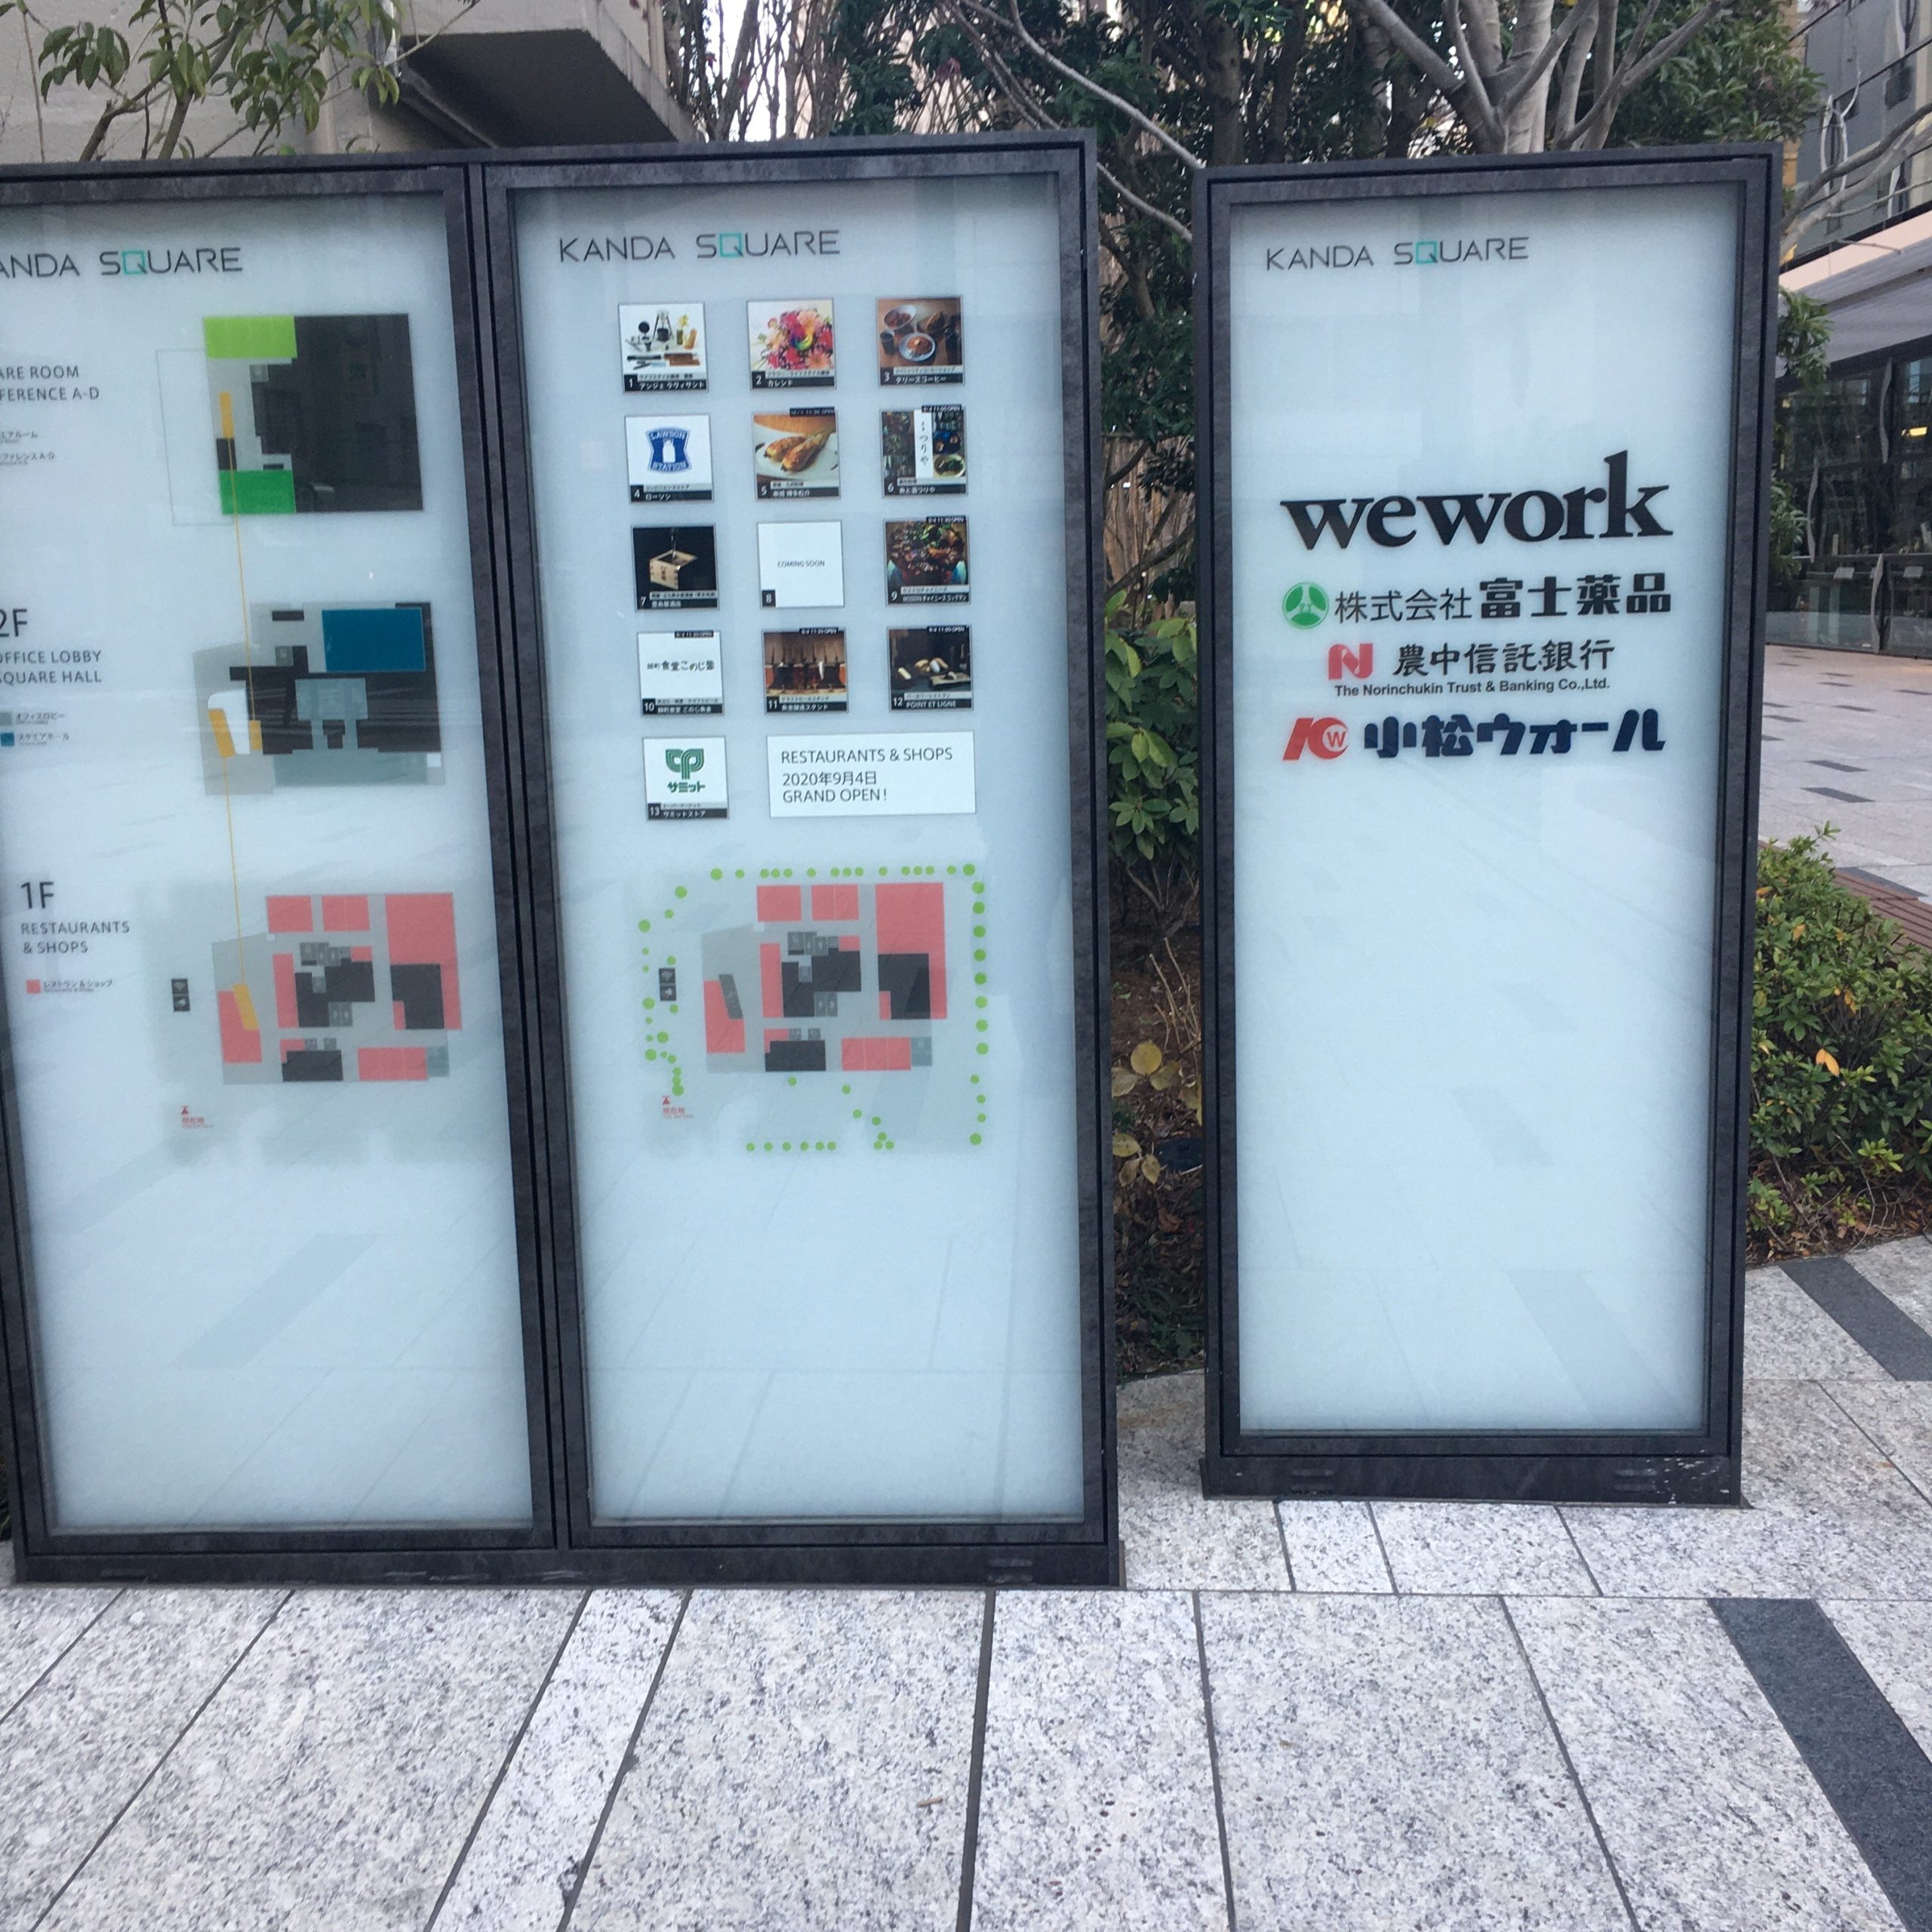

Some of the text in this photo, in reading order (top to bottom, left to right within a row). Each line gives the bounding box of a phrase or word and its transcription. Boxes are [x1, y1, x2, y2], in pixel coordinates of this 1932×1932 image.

[559, 229, 841, 263] KANDA SQUARE
[1266, 236, 1530, 272] KANDA SQUARE
[0, 247, 242, 278] NDA SQUARE
[30, 365, 79, 380] ROOM
[755, 374, 762, 386] 2
[72, 386, 100, 400] A-D
[634, 488, 641, 499] 4
[888, 482, 895, 493] 6
[1280, 450, 1673, 550] wework
[777, 560, 804, 568] COMING
[641, 596, 647, 606] 7
[765, 593, 772, 604] 8
[891, 590, 898, 601] 9
[1334, 572, 1672, 625] 株式会社富士薬品
[0, 608, 28, 638] 2F
[0, 650, 102, 664] FFICE LOBBY
[1392, 638, 1616, 677] 農中信託銀行
[0, 670, 102, 686] QUARE HALL
[1334, 677, 1611, 697] The Norinchukin Trust & Banking Co.,Ltd.
[644, 701, 655, 712] 10
[768, 700, 778, 709] 11
[893, 697, 904, 707] 12
[781, 747, 953, 764] RESTAURANTS & SHOPS
[782, 771, 877, 786] 2020年9月4日
[667, 780, 706, 793] サミット
[783, 789, 835, 803] GRAND
[650, 806, 660, 817] 13
[21, 881, 54, 909] 1F
[20, 921, 131, 935] RESTAURANTS
[23, 940, 88, 955] & SHOPS
